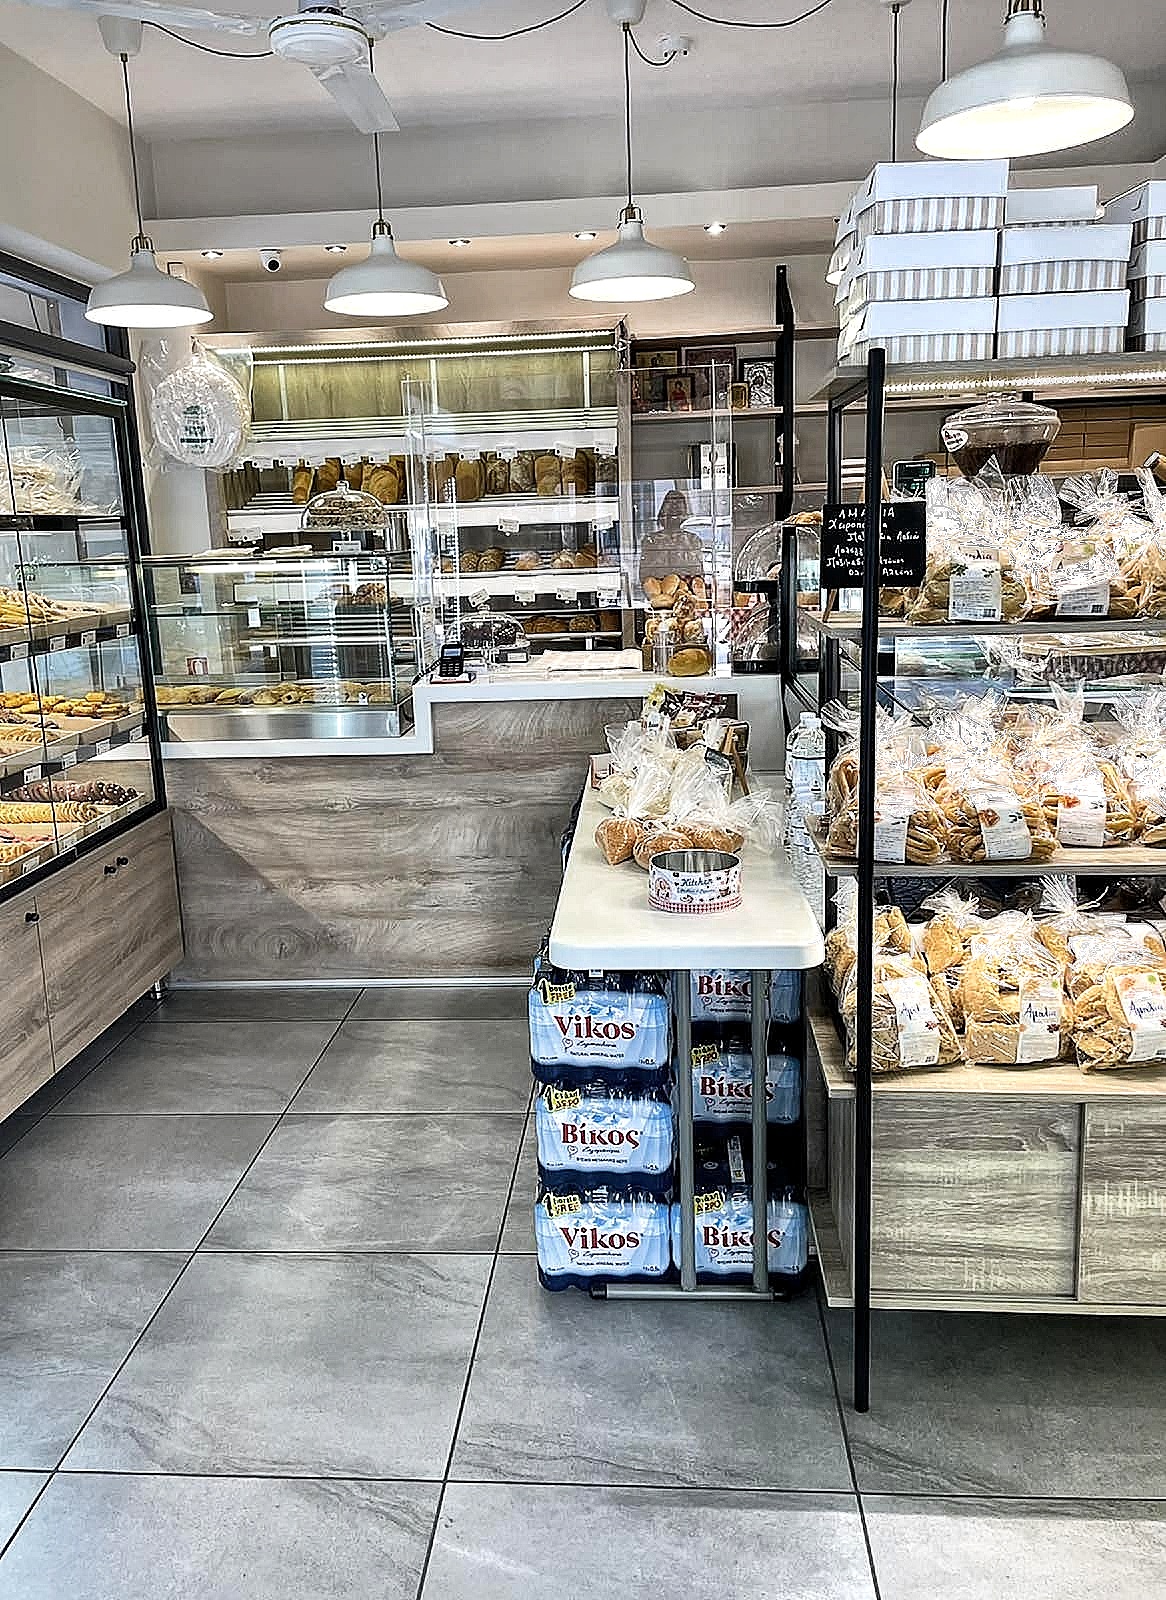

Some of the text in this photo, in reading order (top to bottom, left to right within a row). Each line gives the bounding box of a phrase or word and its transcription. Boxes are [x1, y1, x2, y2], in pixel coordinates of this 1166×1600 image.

[551, 991, 575, 1001] FREE
[554, 1015, 636, 1040] Vikos
[561, 1122, 640, 1150] Βίκος
[560, 1227, 640, 1249] Vikos
[703, 1226, 782, 1249] Βίκς
